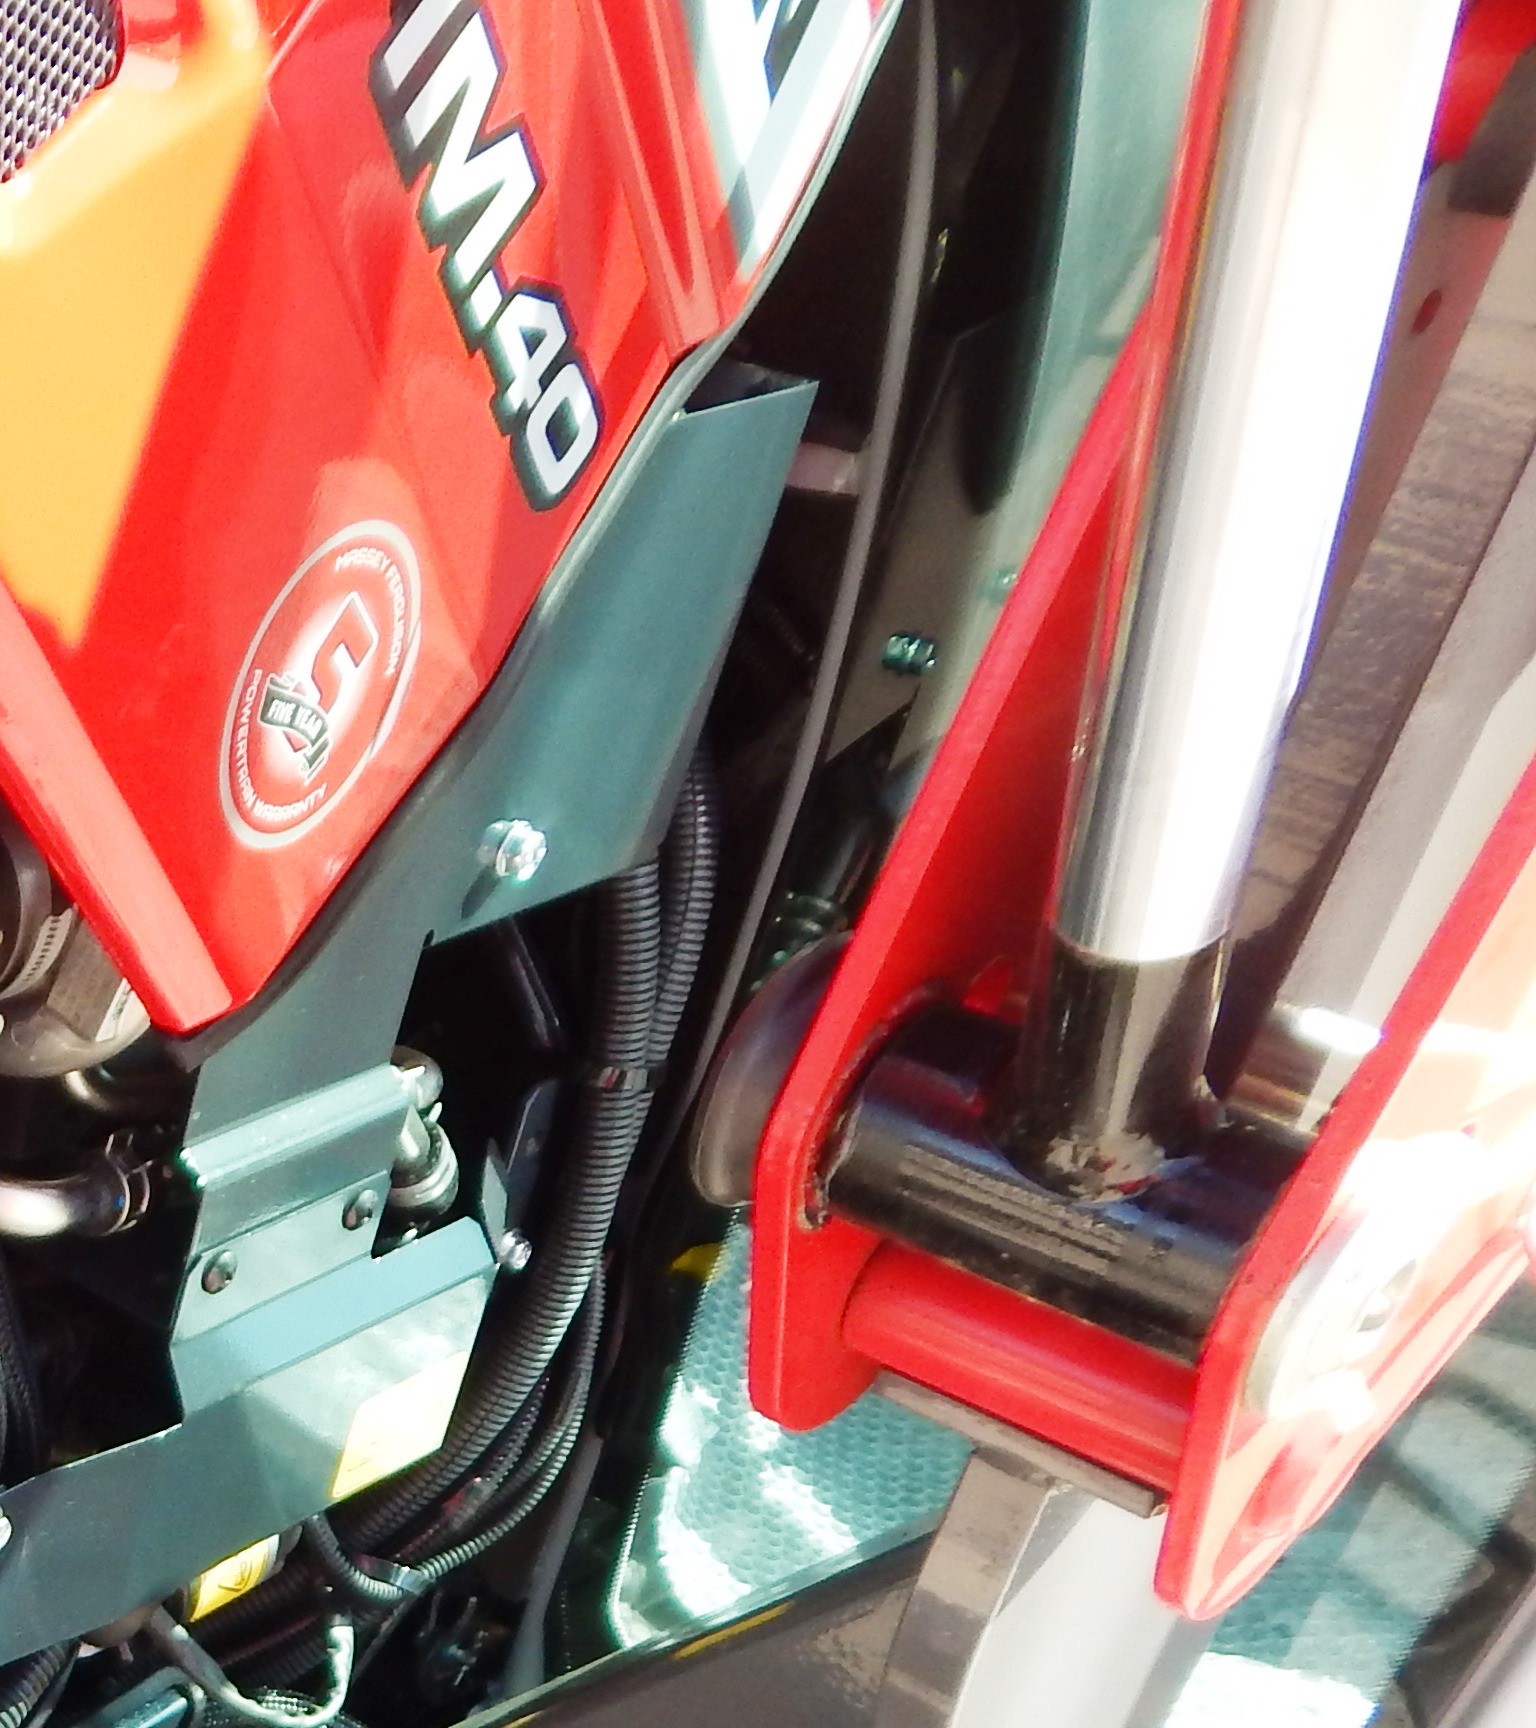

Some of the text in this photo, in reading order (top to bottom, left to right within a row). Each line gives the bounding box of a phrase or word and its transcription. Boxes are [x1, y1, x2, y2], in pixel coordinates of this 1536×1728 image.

[334, 546, 405, 676] MASSEY FERGUSON
[235, 669, 327, 821] POWERTRAIN WARRANTY
[268, 699, 323, 739] FIVE YEAR
